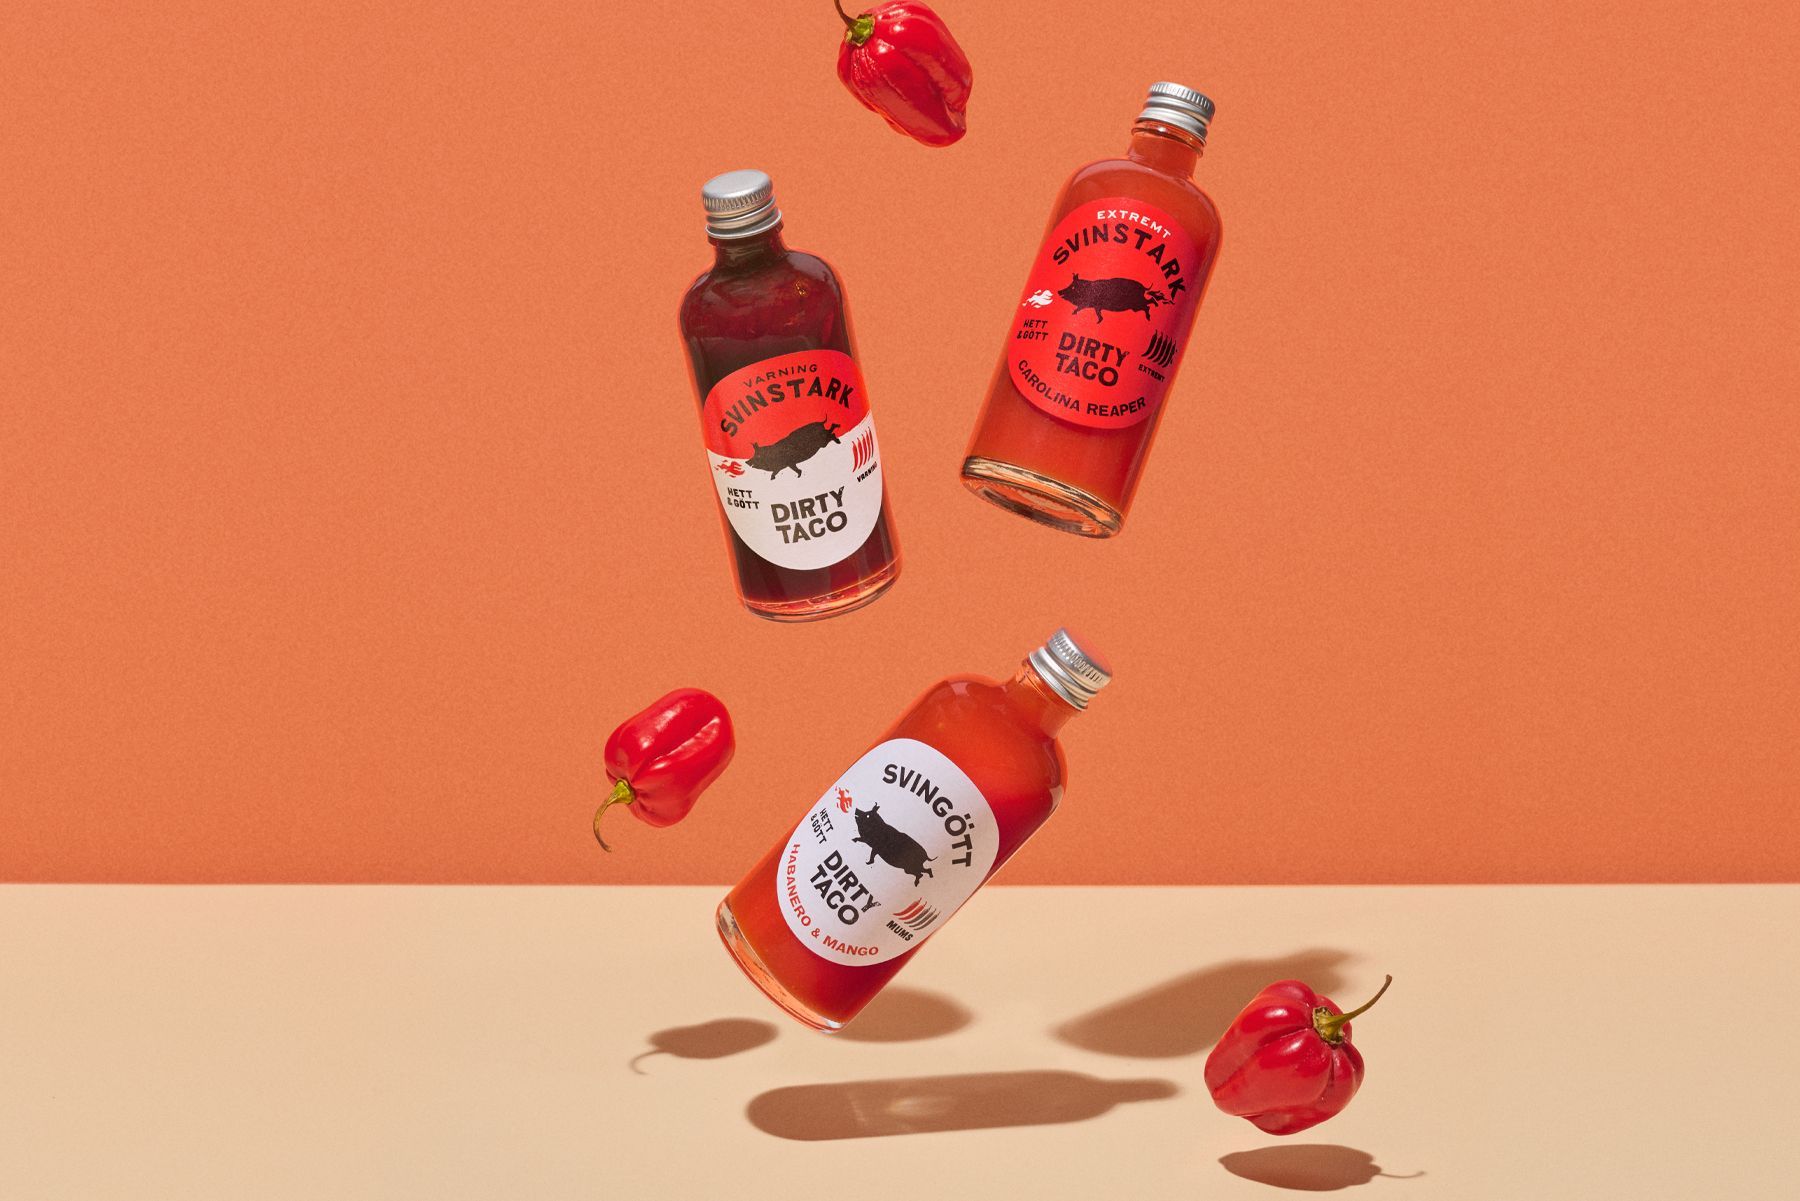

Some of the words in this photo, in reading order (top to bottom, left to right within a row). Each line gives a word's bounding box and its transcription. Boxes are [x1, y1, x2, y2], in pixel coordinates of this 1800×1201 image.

[1097, 210, 1172, 239] EXTREMT
[1052, 223, 1186, 299] SVINSTARK
[1023, 320, 1048, 329] HETT
[1059, 332, 1129, 366] DIRTY
[744, 364, 818, 388] VARNING
[1055, 353, 1118, 387] TACO
[1018, 359, 1080, 411] CAROLINA
[1087, 396, 1146, 417] REAPER
[720, 378, 854, 437] SVINSTARK
[727, 487, 752, 498] HETT
[770, 486, 845, 523] DIRTY
[776, 512, 847, 544] TACO
[820, 808, 833, 832] HETT
[882, 764, 975, 867] SVINGÖTT
[810, 863, 860, 926] TACO
[823, 850, 881, 913] DIRTY
[786, 843, 811, 927] HABANERO
[811, 928, 820, 939] &
[822, 935, 878, 956] MANGO
[886, 920, 913, 941] MUMS
